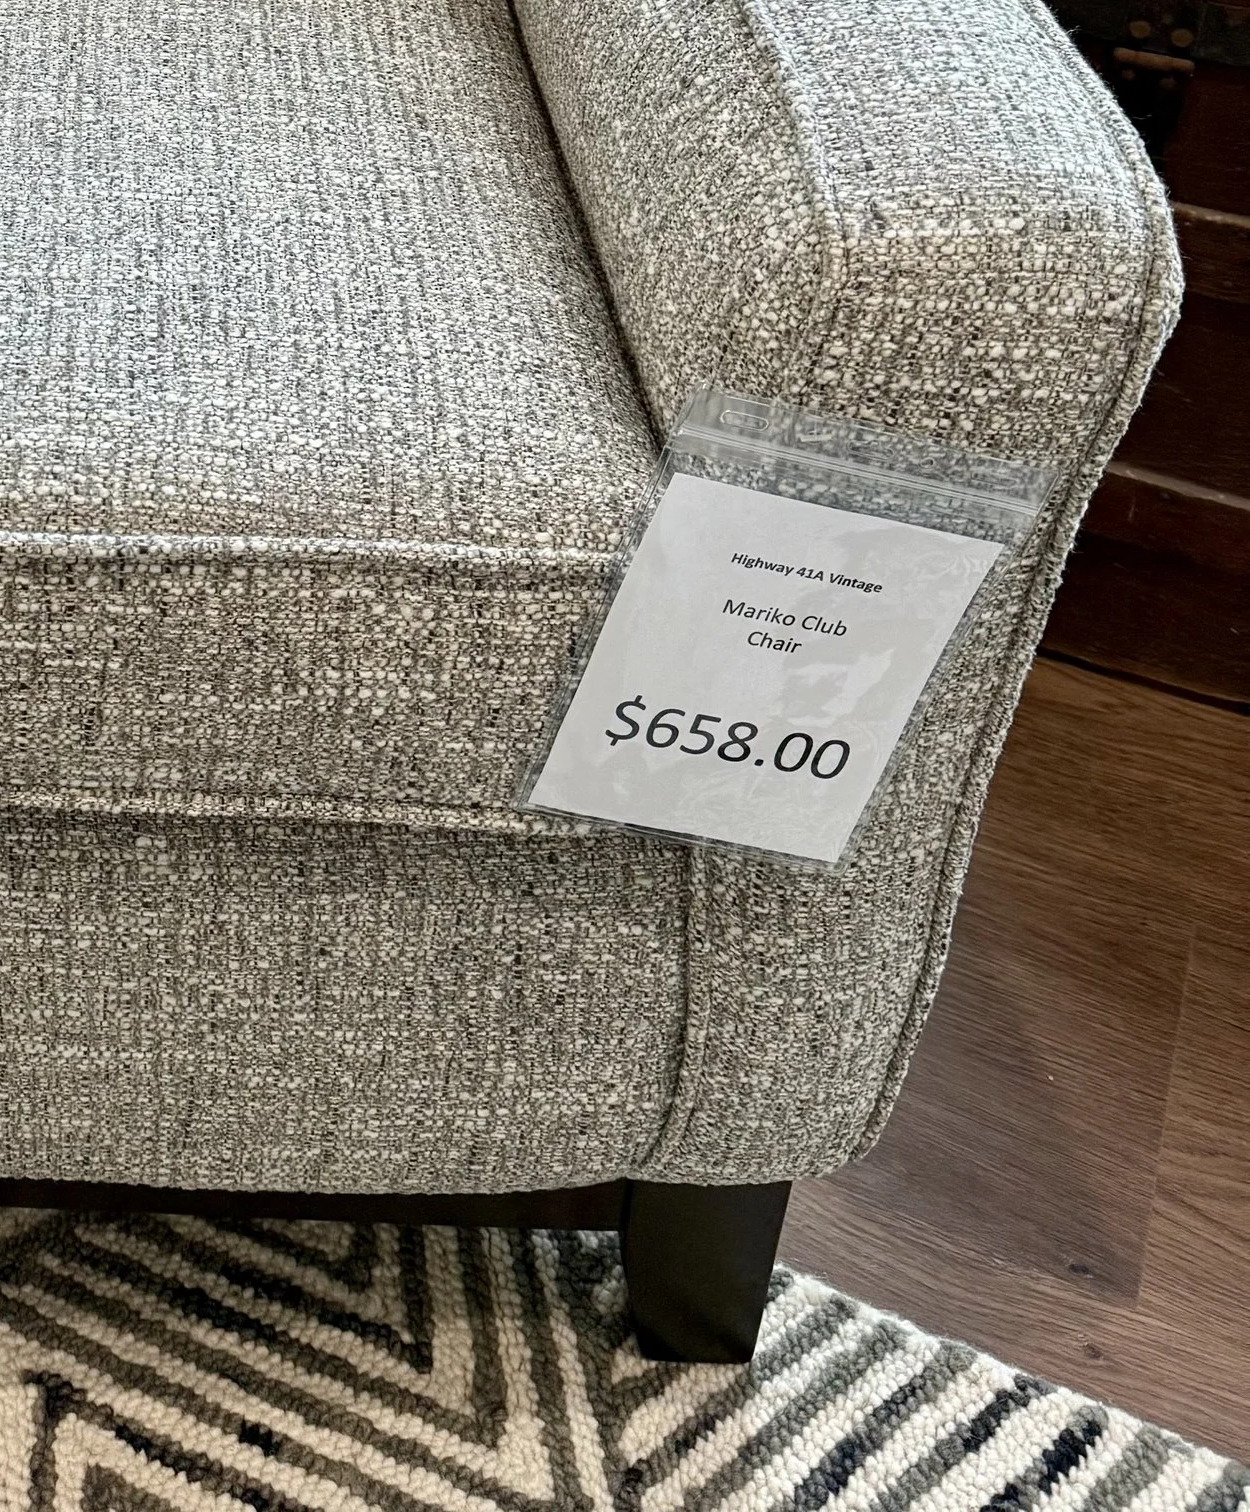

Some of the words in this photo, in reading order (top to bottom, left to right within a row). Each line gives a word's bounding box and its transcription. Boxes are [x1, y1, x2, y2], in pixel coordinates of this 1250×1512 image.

[731, 552, 795, 577] Highway
[796, 567, 825, 581] 41A
[829, 573, 883, 593] Vintage
[722, 599, 797, 627] Mariko
[801, 615, 848, 637] Club
[747, 631, 803, 654] Chair
[605, 695, 851, 780] $658.00
